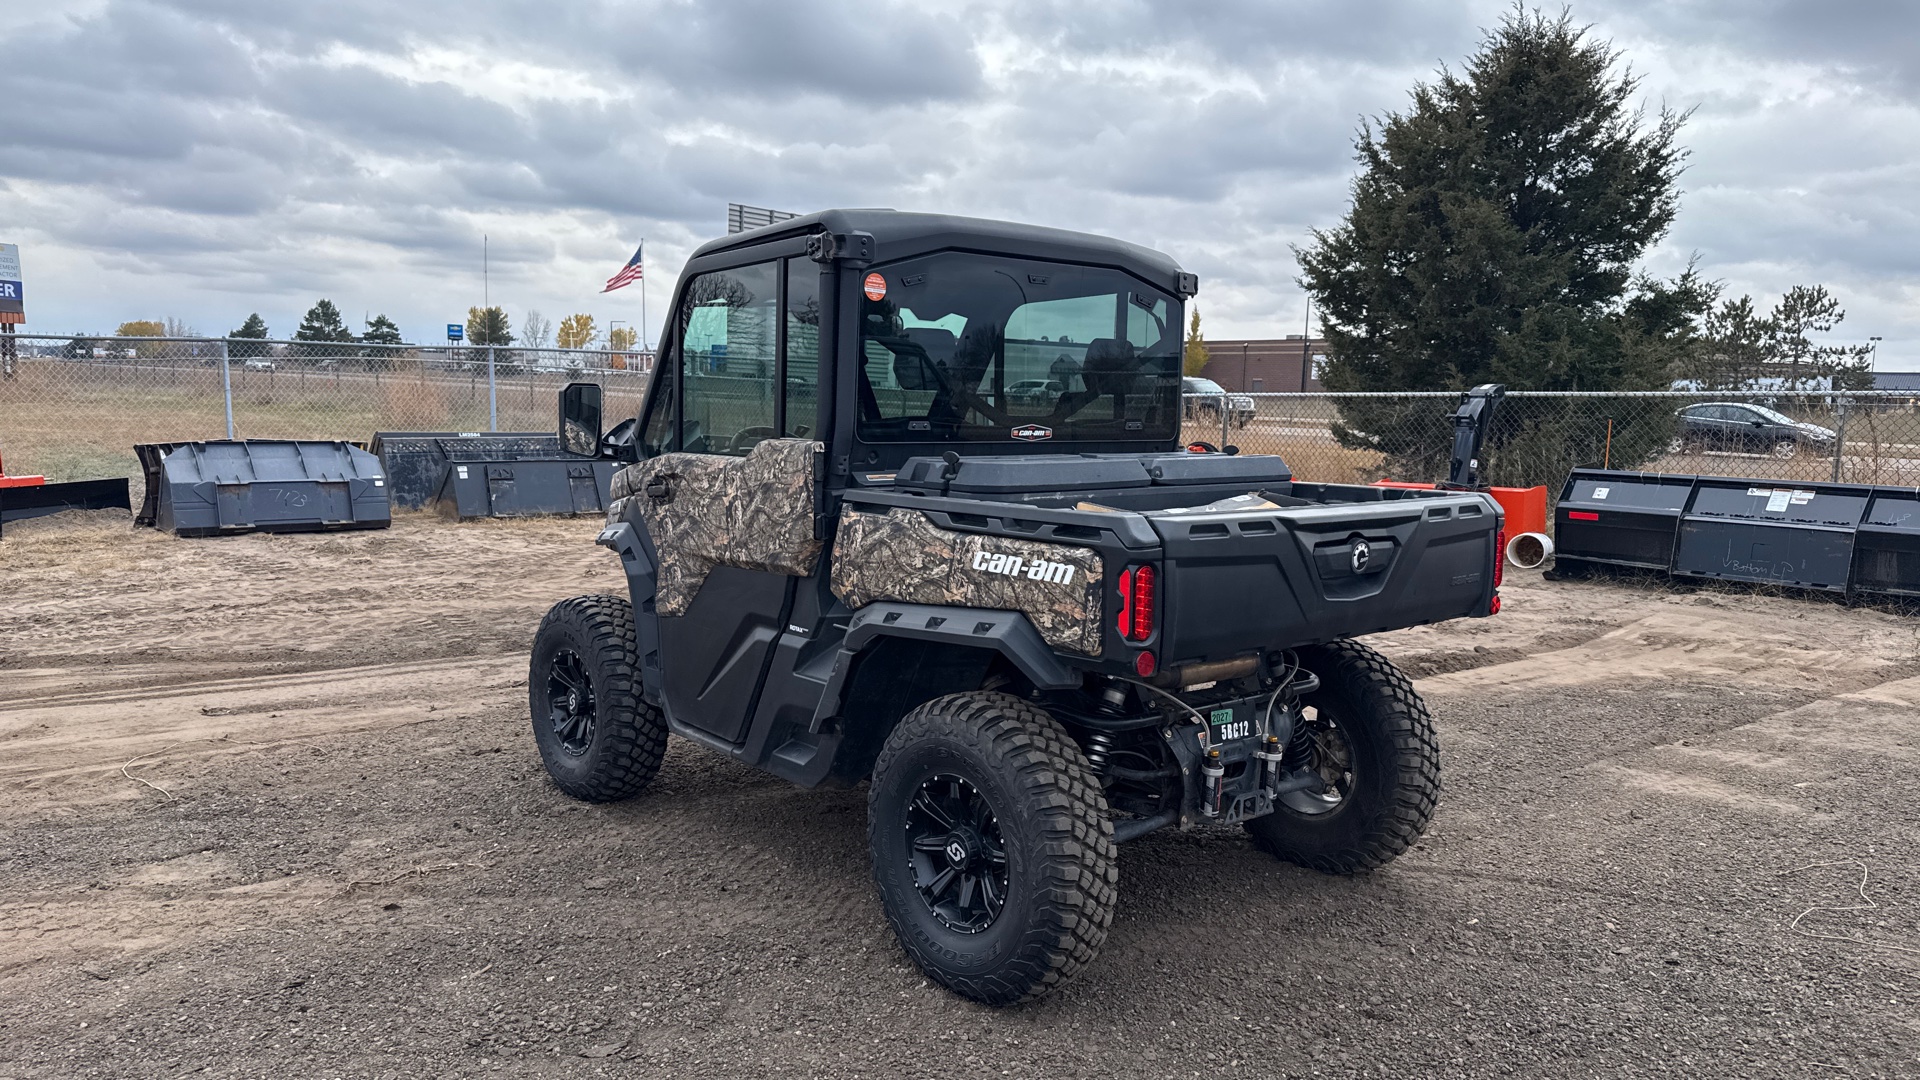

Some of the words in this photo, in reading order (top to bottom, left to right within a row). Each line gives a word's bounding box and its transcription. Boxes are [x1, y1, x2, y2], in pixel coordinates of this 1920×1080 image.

[268, 488, 308, 507] 7123
[972, 551, 1075, 586] can-am
[1732, 559, 1768, 574] Bottom
[1212, 711, 1229, 723] 2027
[1221, 720, 1249, 740] 5BC12
